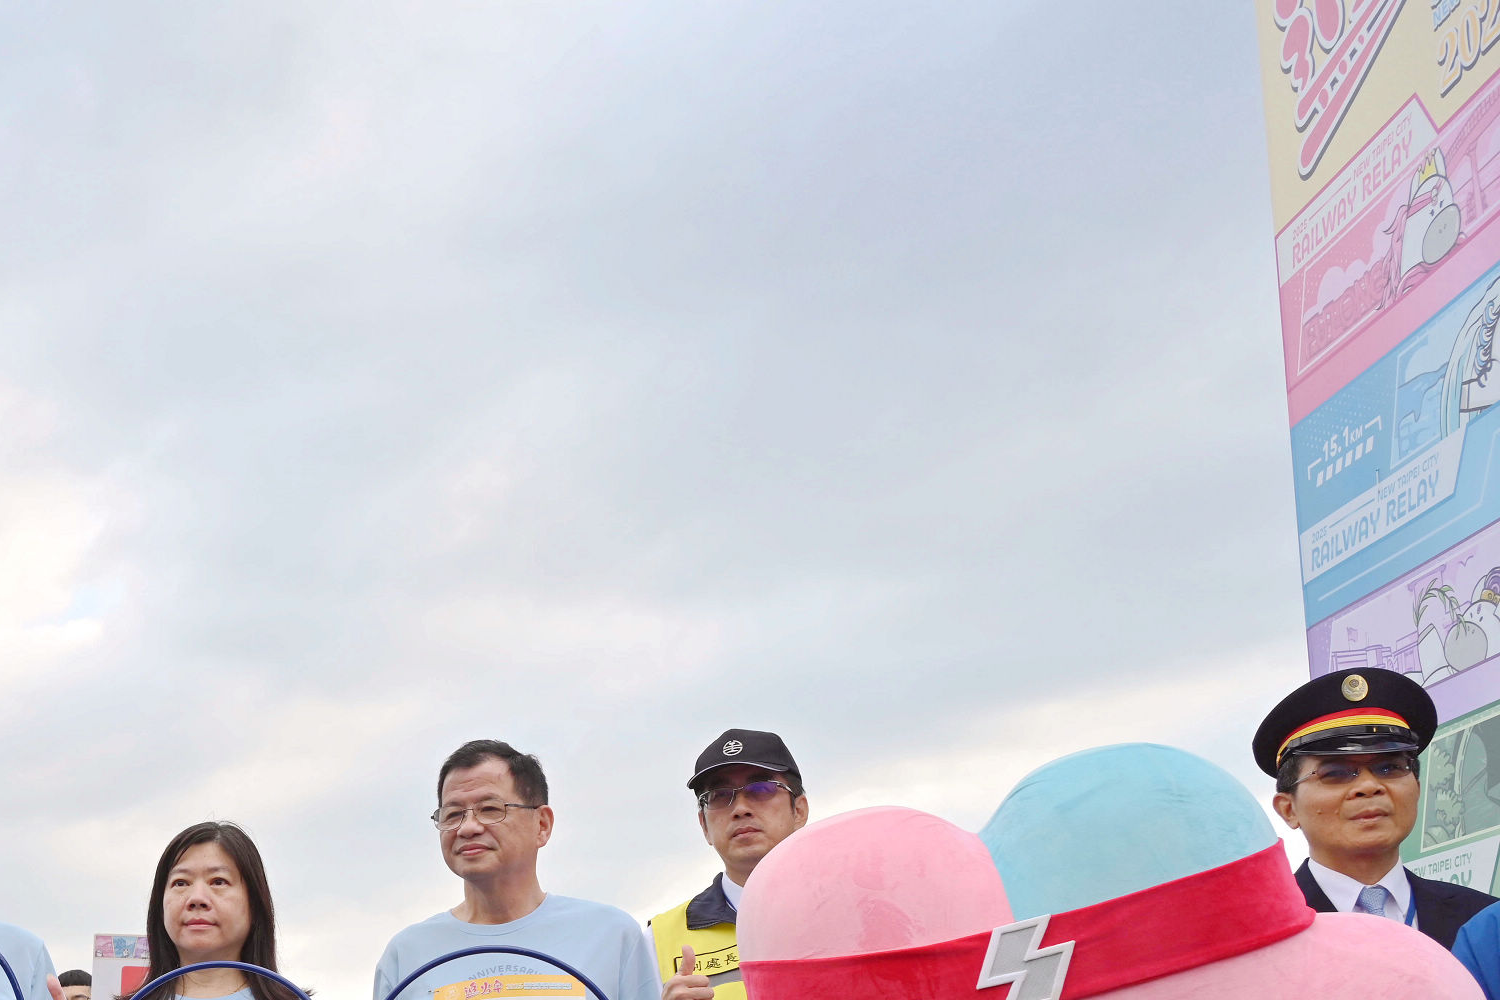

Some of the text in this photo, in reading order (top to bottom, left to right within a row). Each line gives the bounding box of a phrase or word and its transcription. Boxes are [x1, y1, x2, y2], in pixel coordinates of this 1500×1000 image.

[1353, 157, 1371, 181] NEW
[1372, 131, 1395, 157] TAIPEI
[1396, 111, 1413, 137] CITY
[1292, 129, 1413, 269] RAILWAY RELAY
[1311, 469, 1440, 572] RAILWAY RELAY
[1312, 452, 1440, 545] 2025 NEW TAIPEI CITY
[1428, 858, 1452, 876] TAIPEI
[1454, 851, 1472, 868] CITY
